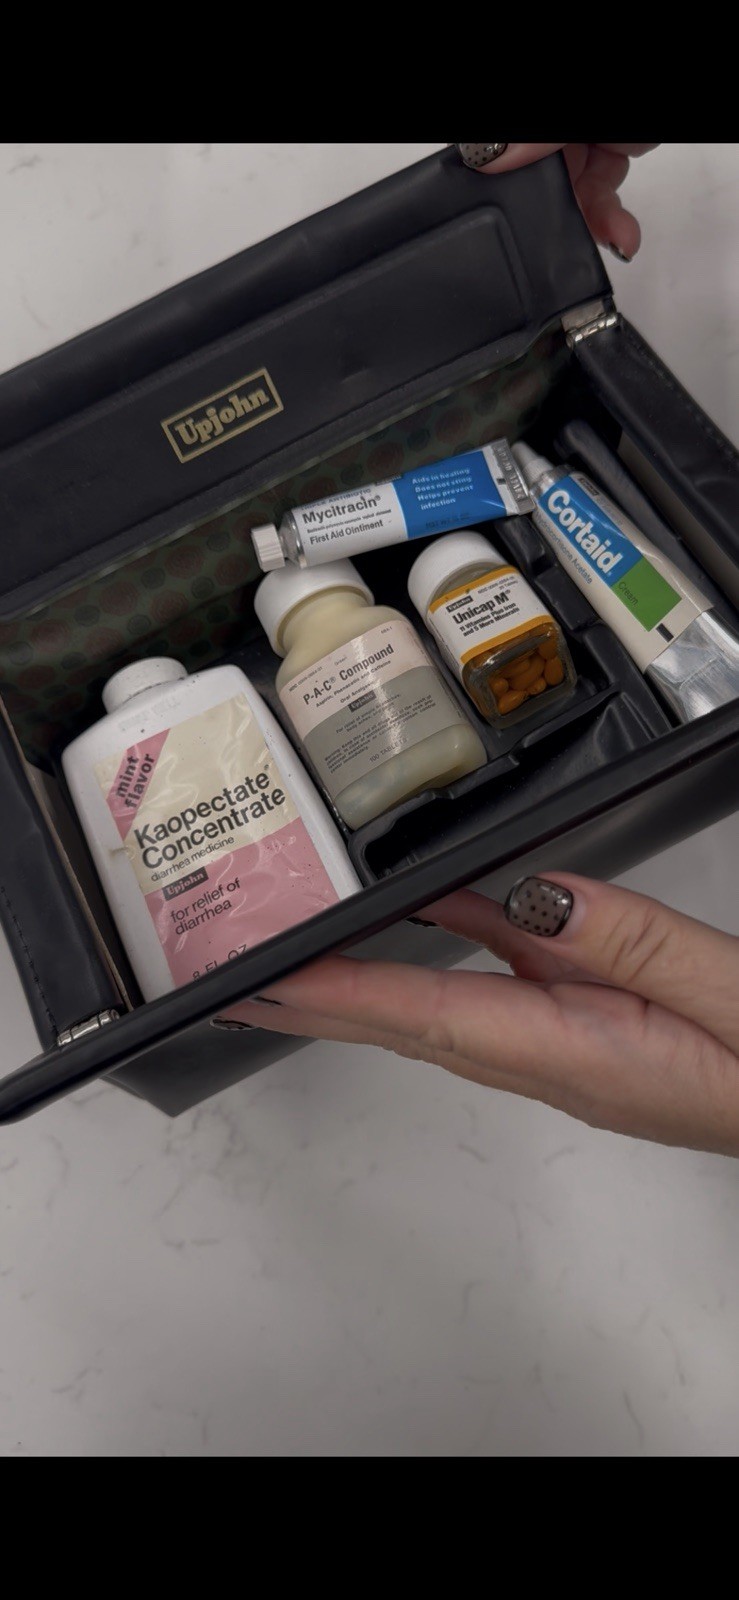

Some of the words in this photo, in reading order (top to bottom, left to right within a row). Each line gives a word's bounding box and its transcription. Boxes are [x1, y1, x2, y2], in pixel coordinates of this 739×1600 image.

[175, 388, 269, 445] Upjohn
[412, 476, 430, 485] Aids
[440, 468, 471, 480] healing
[415, 485, 436, 494] Does
[436, 480, 450, 490] not
[451, 476, 473, 486] sting
[417, 493, 442, 502] Helps
[442, 484, 474, 499] prevent
[420, 497, 456, 511] infection
[309, 533, 329, 545] First
[330, 528, 344, 540] Aid
[345, 519, 384, 535] Ointment
[571, 558, 593, 585] Acetate
[618, 581, 639, 607] Cream
[452, 599, 496, 624] Unicap
[463, 628, 475, 637] and
[479, 619, 495, 629] More
[495, 606, 520, 621] Minerals
[465, 614, 492, 629] Vitamins
[491, 608, 505, 618] Plus
[504, 602, 517, 611] Iron
[339, 643, 395, 681] Compound
[369, 753, 381, 764] 100
[115, 755, 140, 799] mint
[124, 753, 156, 810] flavor
[141, 787, 287, 870] Concentrate
[150, 857, 192, 884] diarrhea
[190, 834, 236, 863] medicine
[165, 870, 206, 896] Upjohn
[169, 905, 192, 925] for
[190, 887, 228, 912] relief
[228, 877, 242, 893] of
[174, 899, 233, 937] diarrhea
